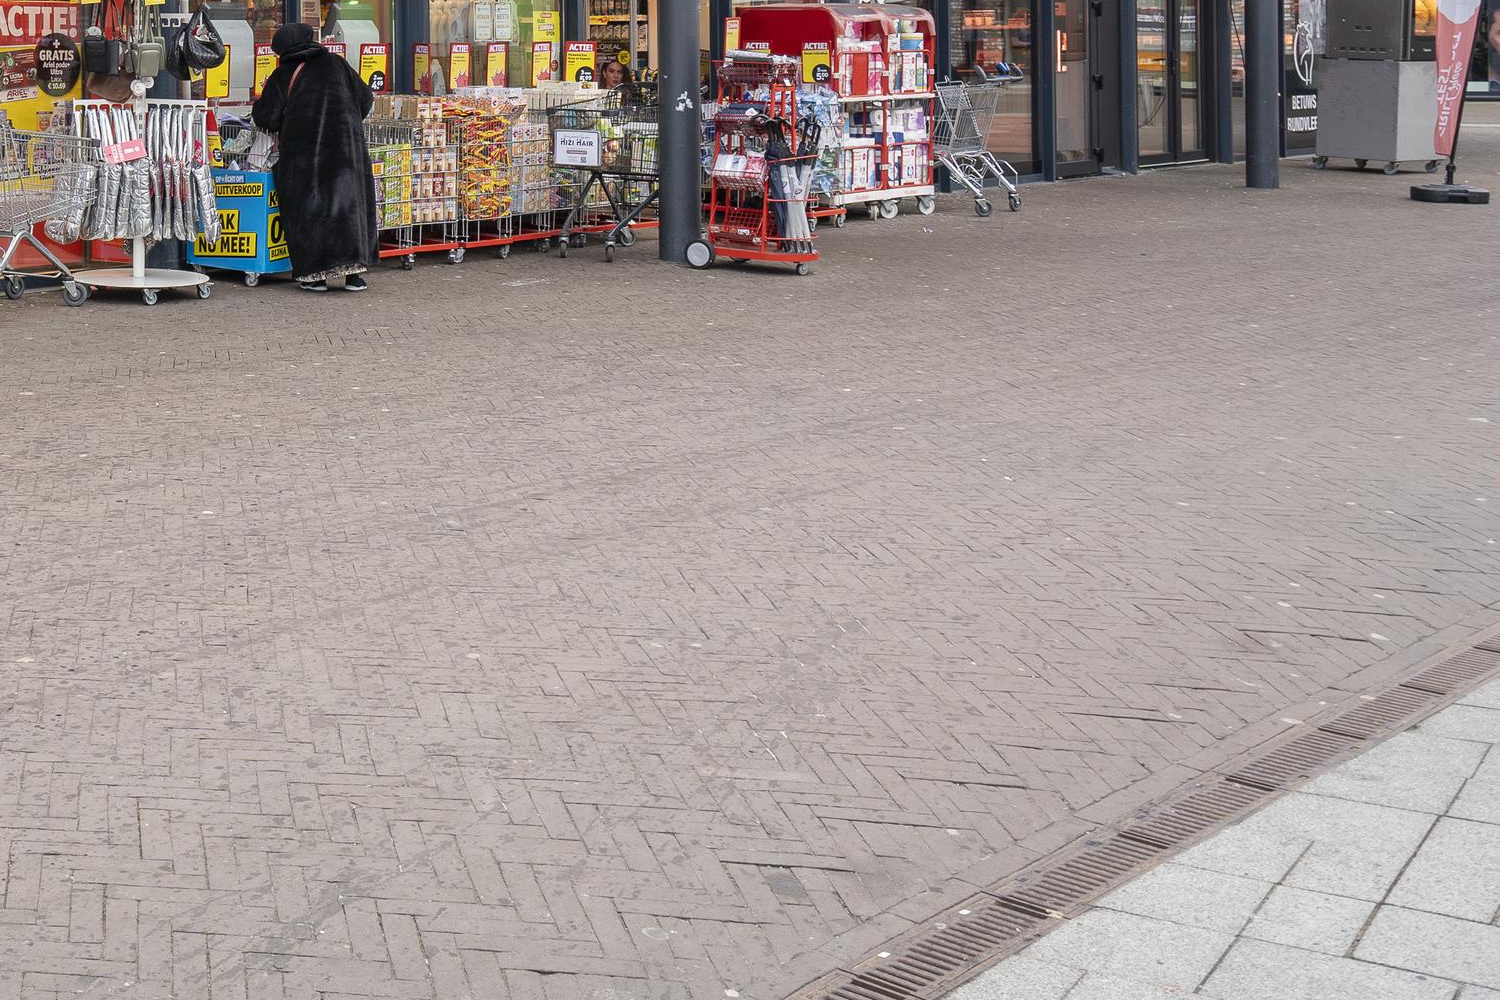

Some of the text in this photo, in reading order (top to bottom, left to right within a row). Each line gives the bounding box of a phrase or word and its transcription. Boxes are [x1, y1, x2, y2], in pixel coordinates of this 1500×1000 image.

[363, 45, 386, 54] ACTIE!
[569, 43, 593, 51] ACTIE!
[39, 50, 74, 60] GRATIS
[7, 89, 28, 98] ARIEL
[1292, 94, 1317, 110] BETUWS
[576, 138, 593, 146] HAIR
[217, 184, 261, 195] UITVERKOOP
[220, 236, 250, 253] MEE!
